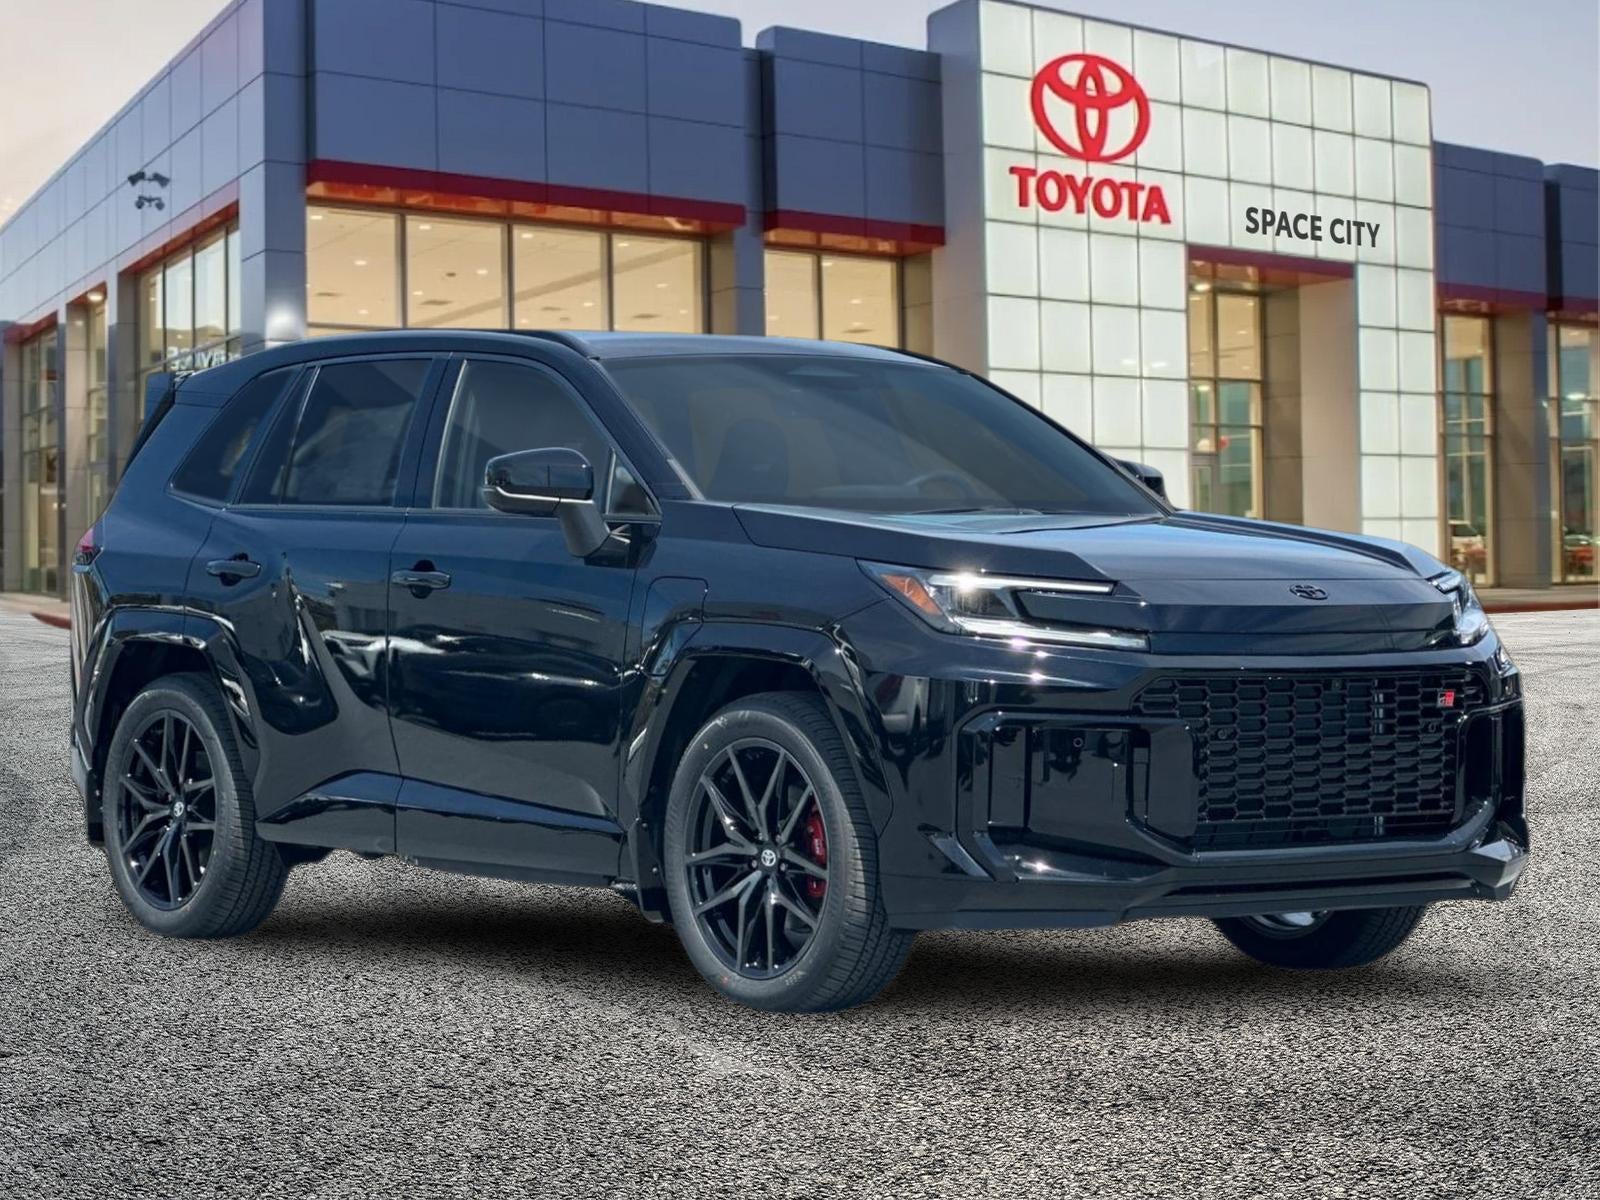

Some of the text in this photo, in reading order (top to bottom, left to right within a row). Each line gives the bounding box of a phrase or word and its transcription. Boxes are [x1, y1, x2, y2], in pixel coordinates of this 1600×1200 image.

[1009, 166, 1171, 224] TOYOTA
[1245, 206, 1380, 247] SPACE CITY
